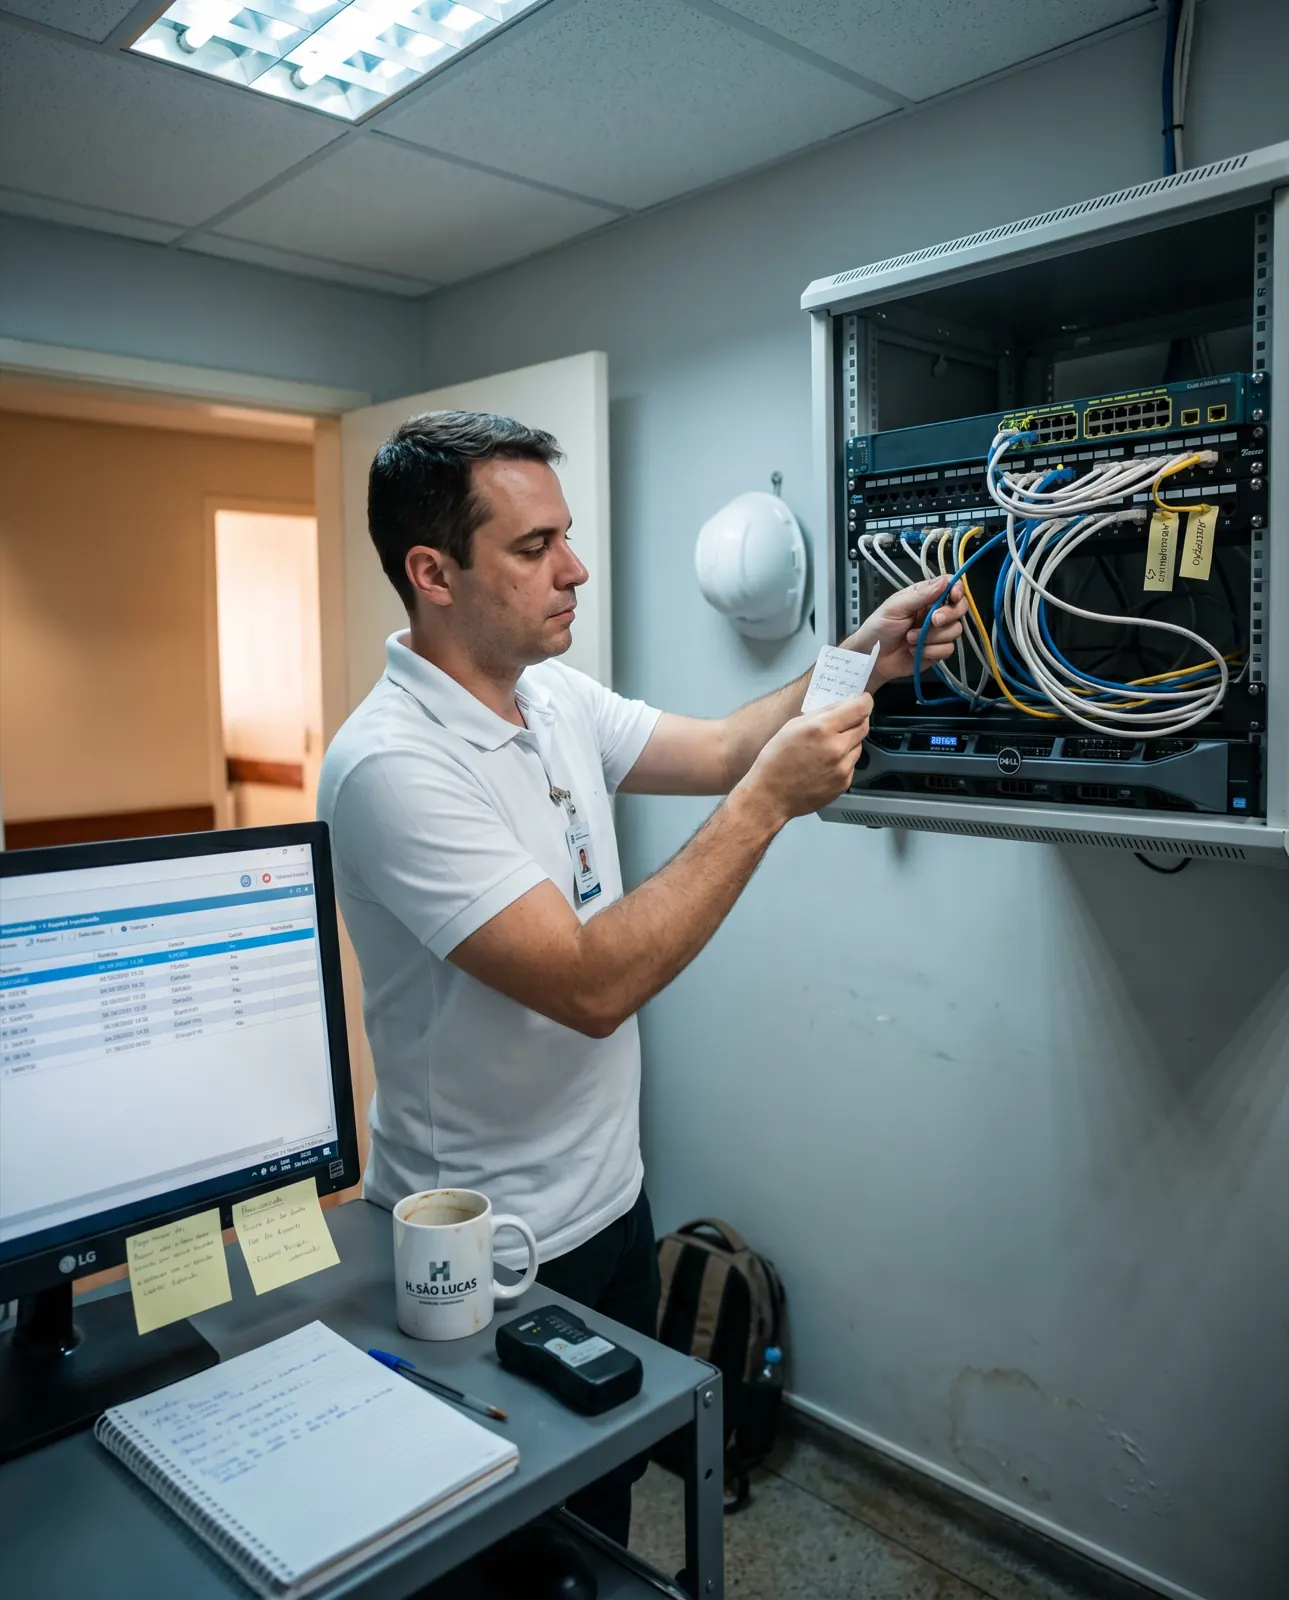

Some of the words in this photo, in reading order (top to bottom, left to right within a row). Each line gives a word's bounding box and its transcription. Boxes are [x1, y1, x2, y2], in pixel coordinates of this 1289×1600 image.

[1000, 757, 1018, 765] DELL
[78, 1250, 97, 1266] LG
[405, 1280, 415, 1293] H.
[416, 1282, 439, 1296] SÃO
[442, 1278, 477, 1296] LUCAS
